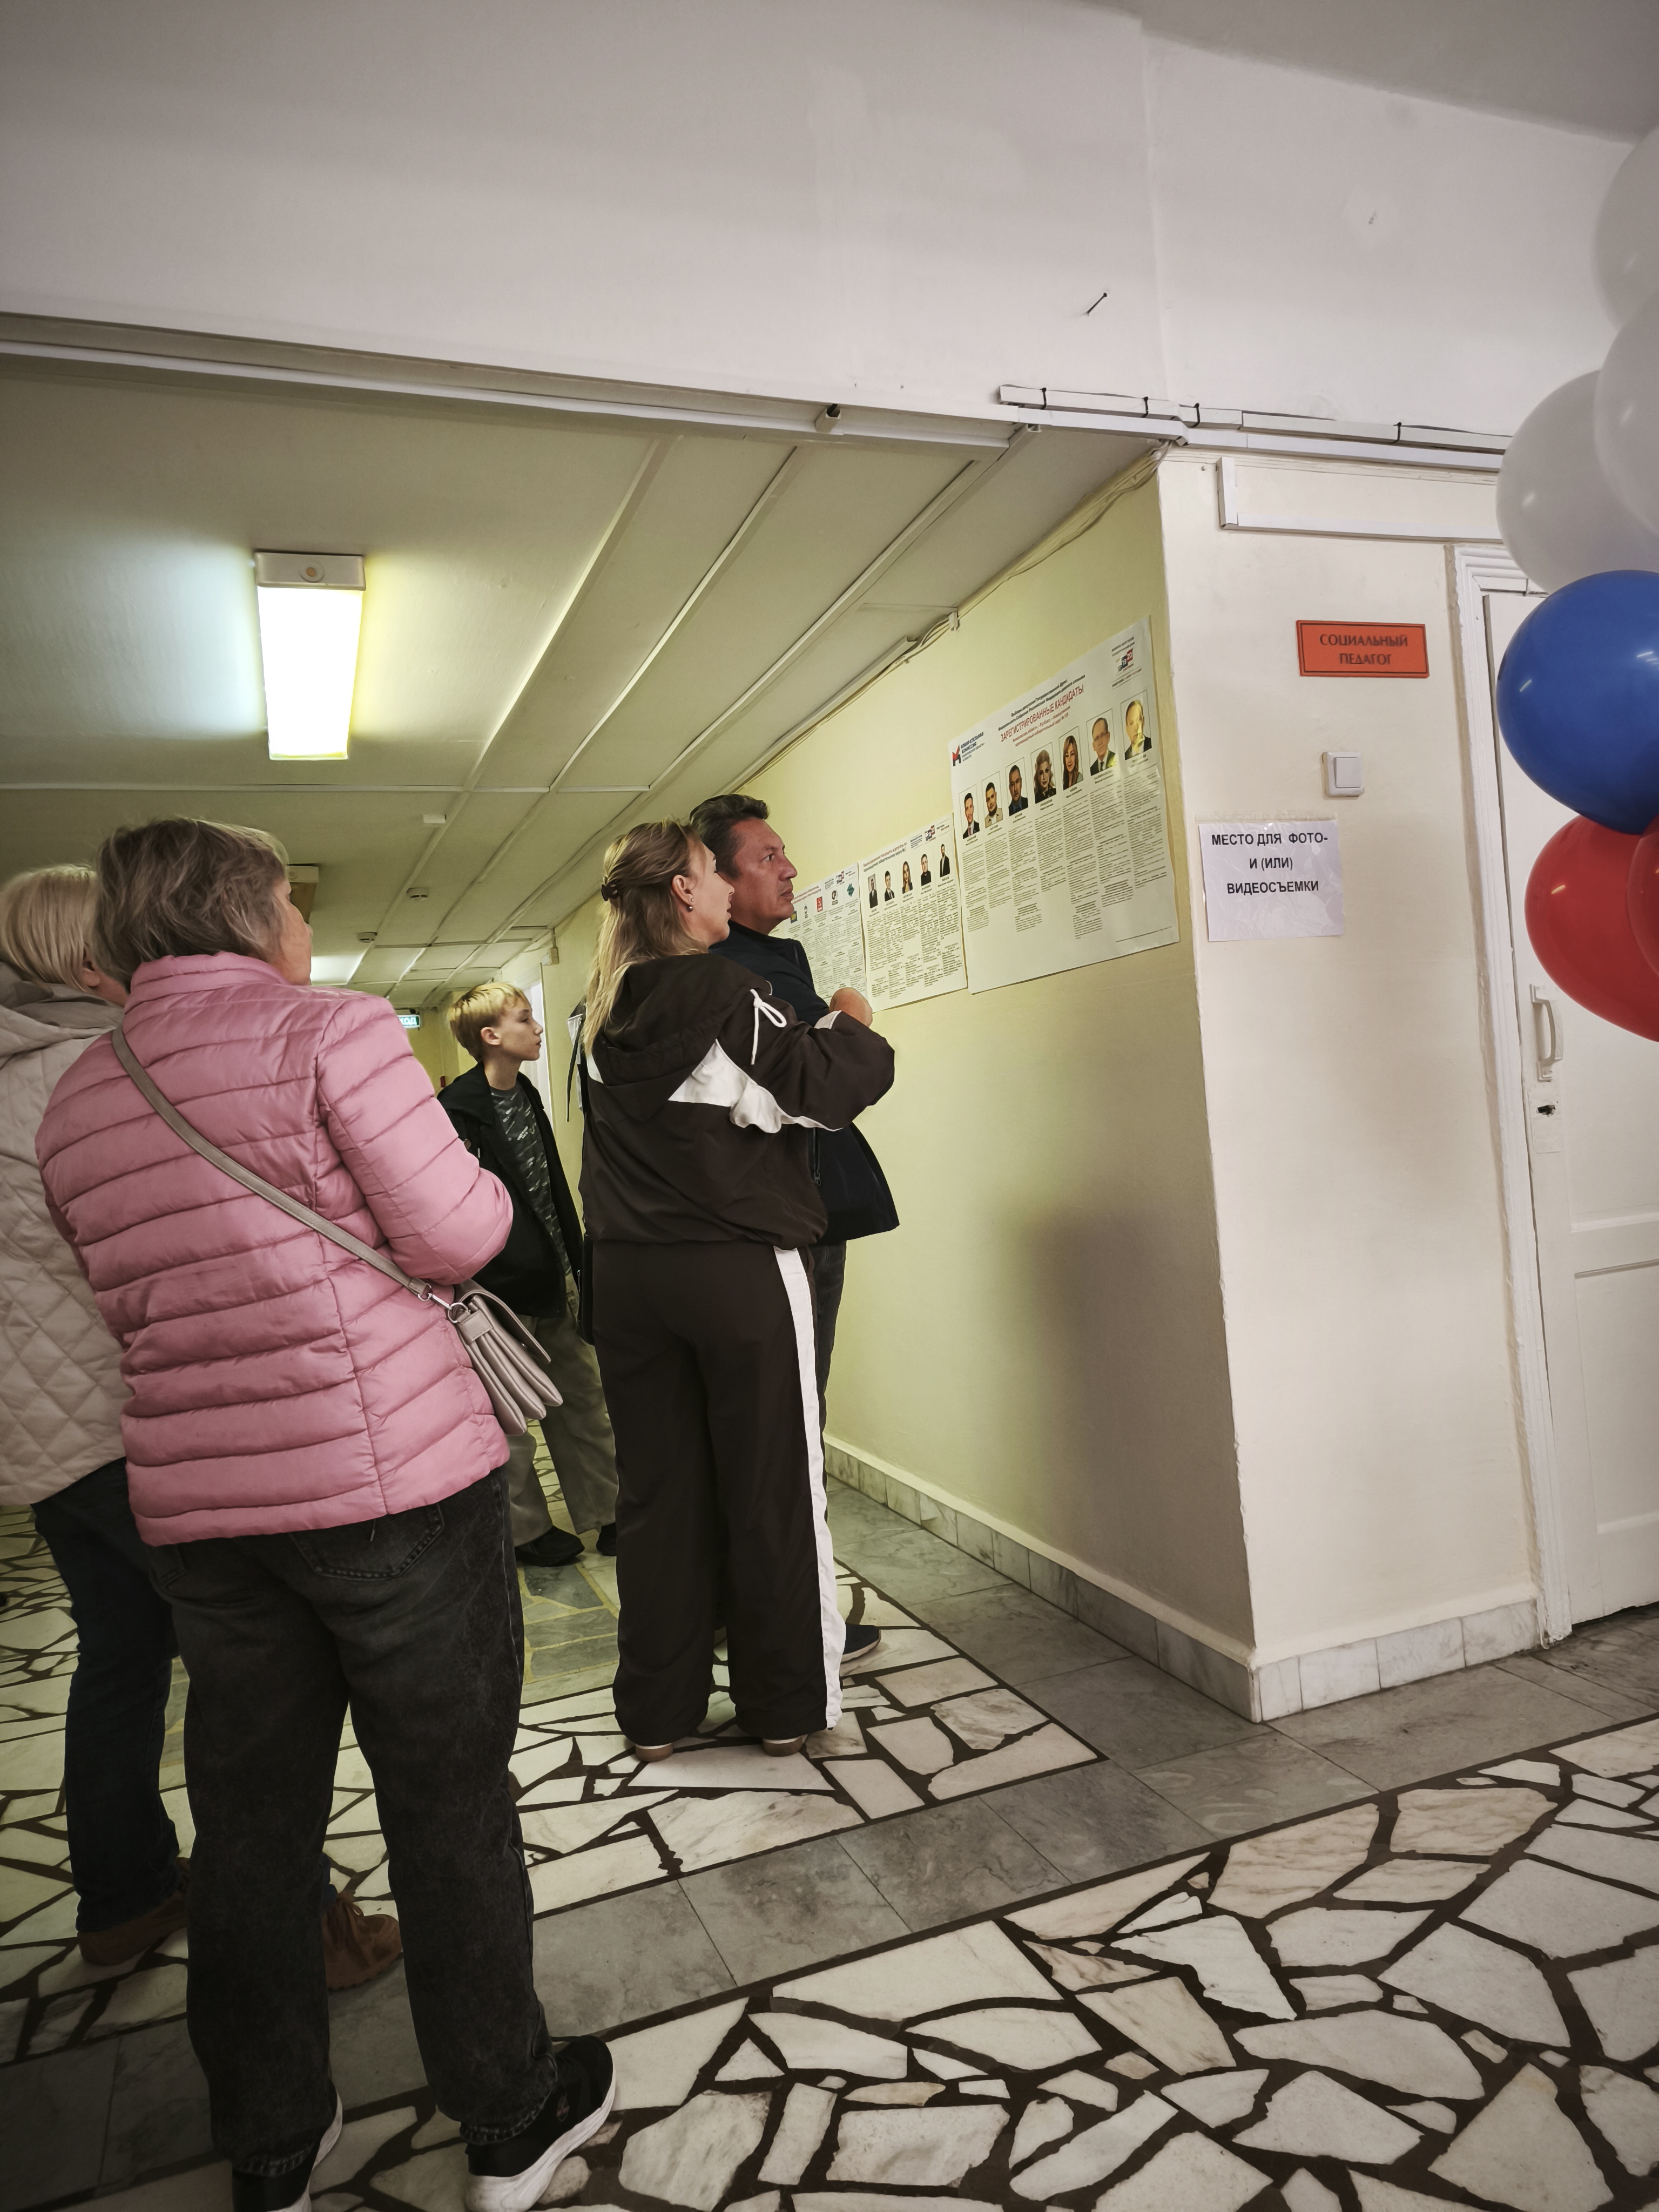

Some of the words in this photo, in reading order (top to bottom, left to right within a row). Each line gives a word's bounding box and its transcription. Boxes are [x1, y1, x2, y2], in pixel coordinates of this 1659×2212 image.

[1319, 633, 1408, 646] СОЦИАЛЬНЫЙ
[1127, 651, 1132, 660] 20
[1339, 653, 1392, 665] ПЕДАГОГ
[1000, 703, 1055, 742] ЗАРЕГИСТРИРОВАННЫЕ
[1055, 684, 1084, 710] КАНДИДАТЫ
[1211, 834, 1254, 845] МЕСТО
[1257, 833, 1282, 846] ДЛЯ
[1288, 832, 1328, 844] ФОТО-
[1249, 858, 1257, 869] И
[1261, 857, 1293, 872] (ИЛИ)
[1226, 880, 1319, 895] ВИДЕОСЪЕМКИ
[399, 1017, 417, 1025] ХОД
